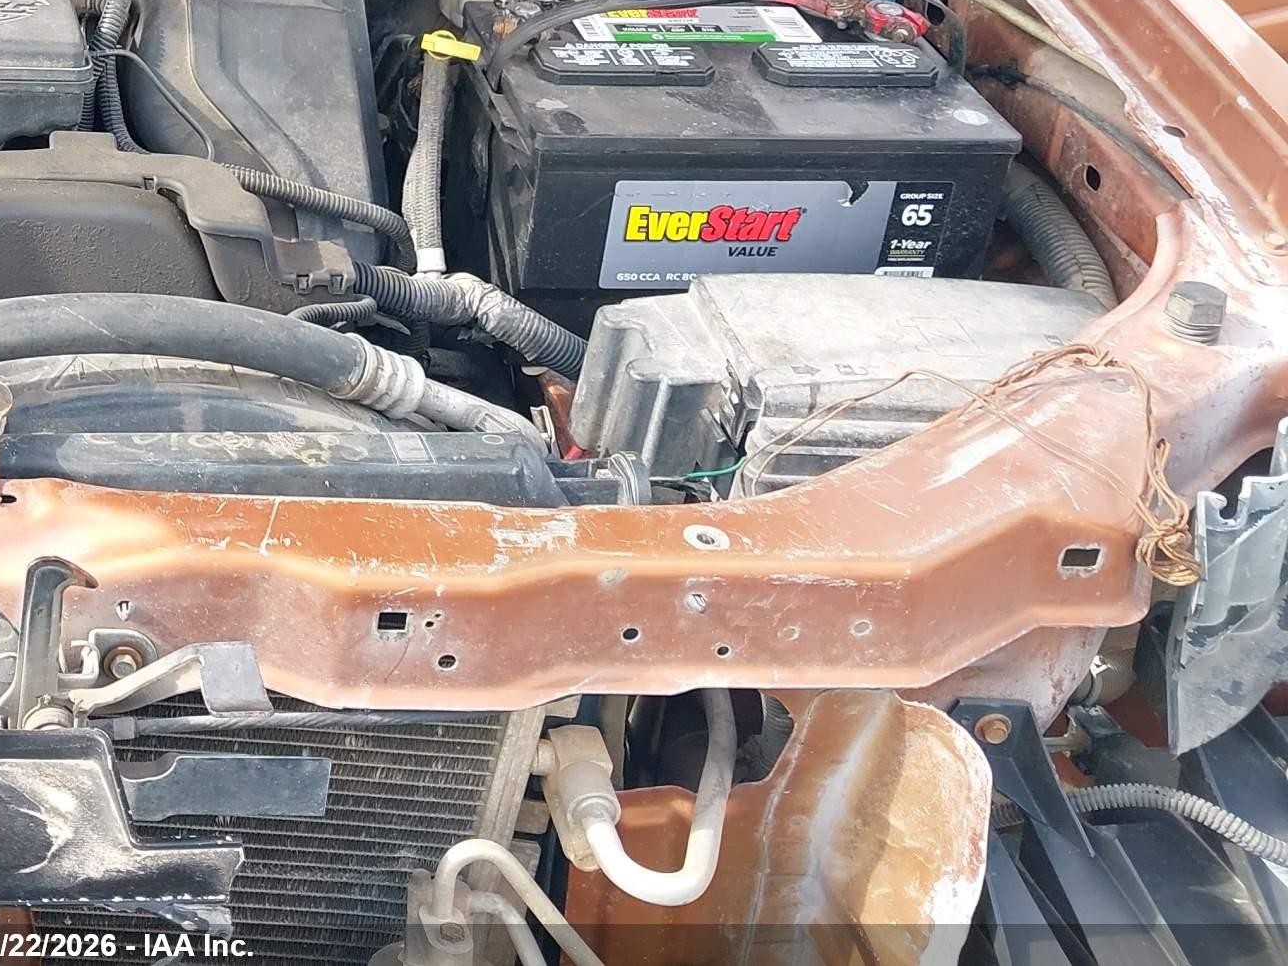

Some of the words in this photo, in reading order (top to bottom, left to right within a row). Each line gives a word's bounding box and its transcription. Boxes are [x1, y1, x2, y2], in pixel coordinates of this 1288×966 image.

[901, 203, 935, 227] 65
[625, 205, 804, 242] EverStart
[890, 239, 932, 250] 1-Year
[728, 246, 779, 258] VALUE
[616, 273, 638, 281] 650
[639, 273, 661, 281] CCA
[666, 273, 681, 281] RC
